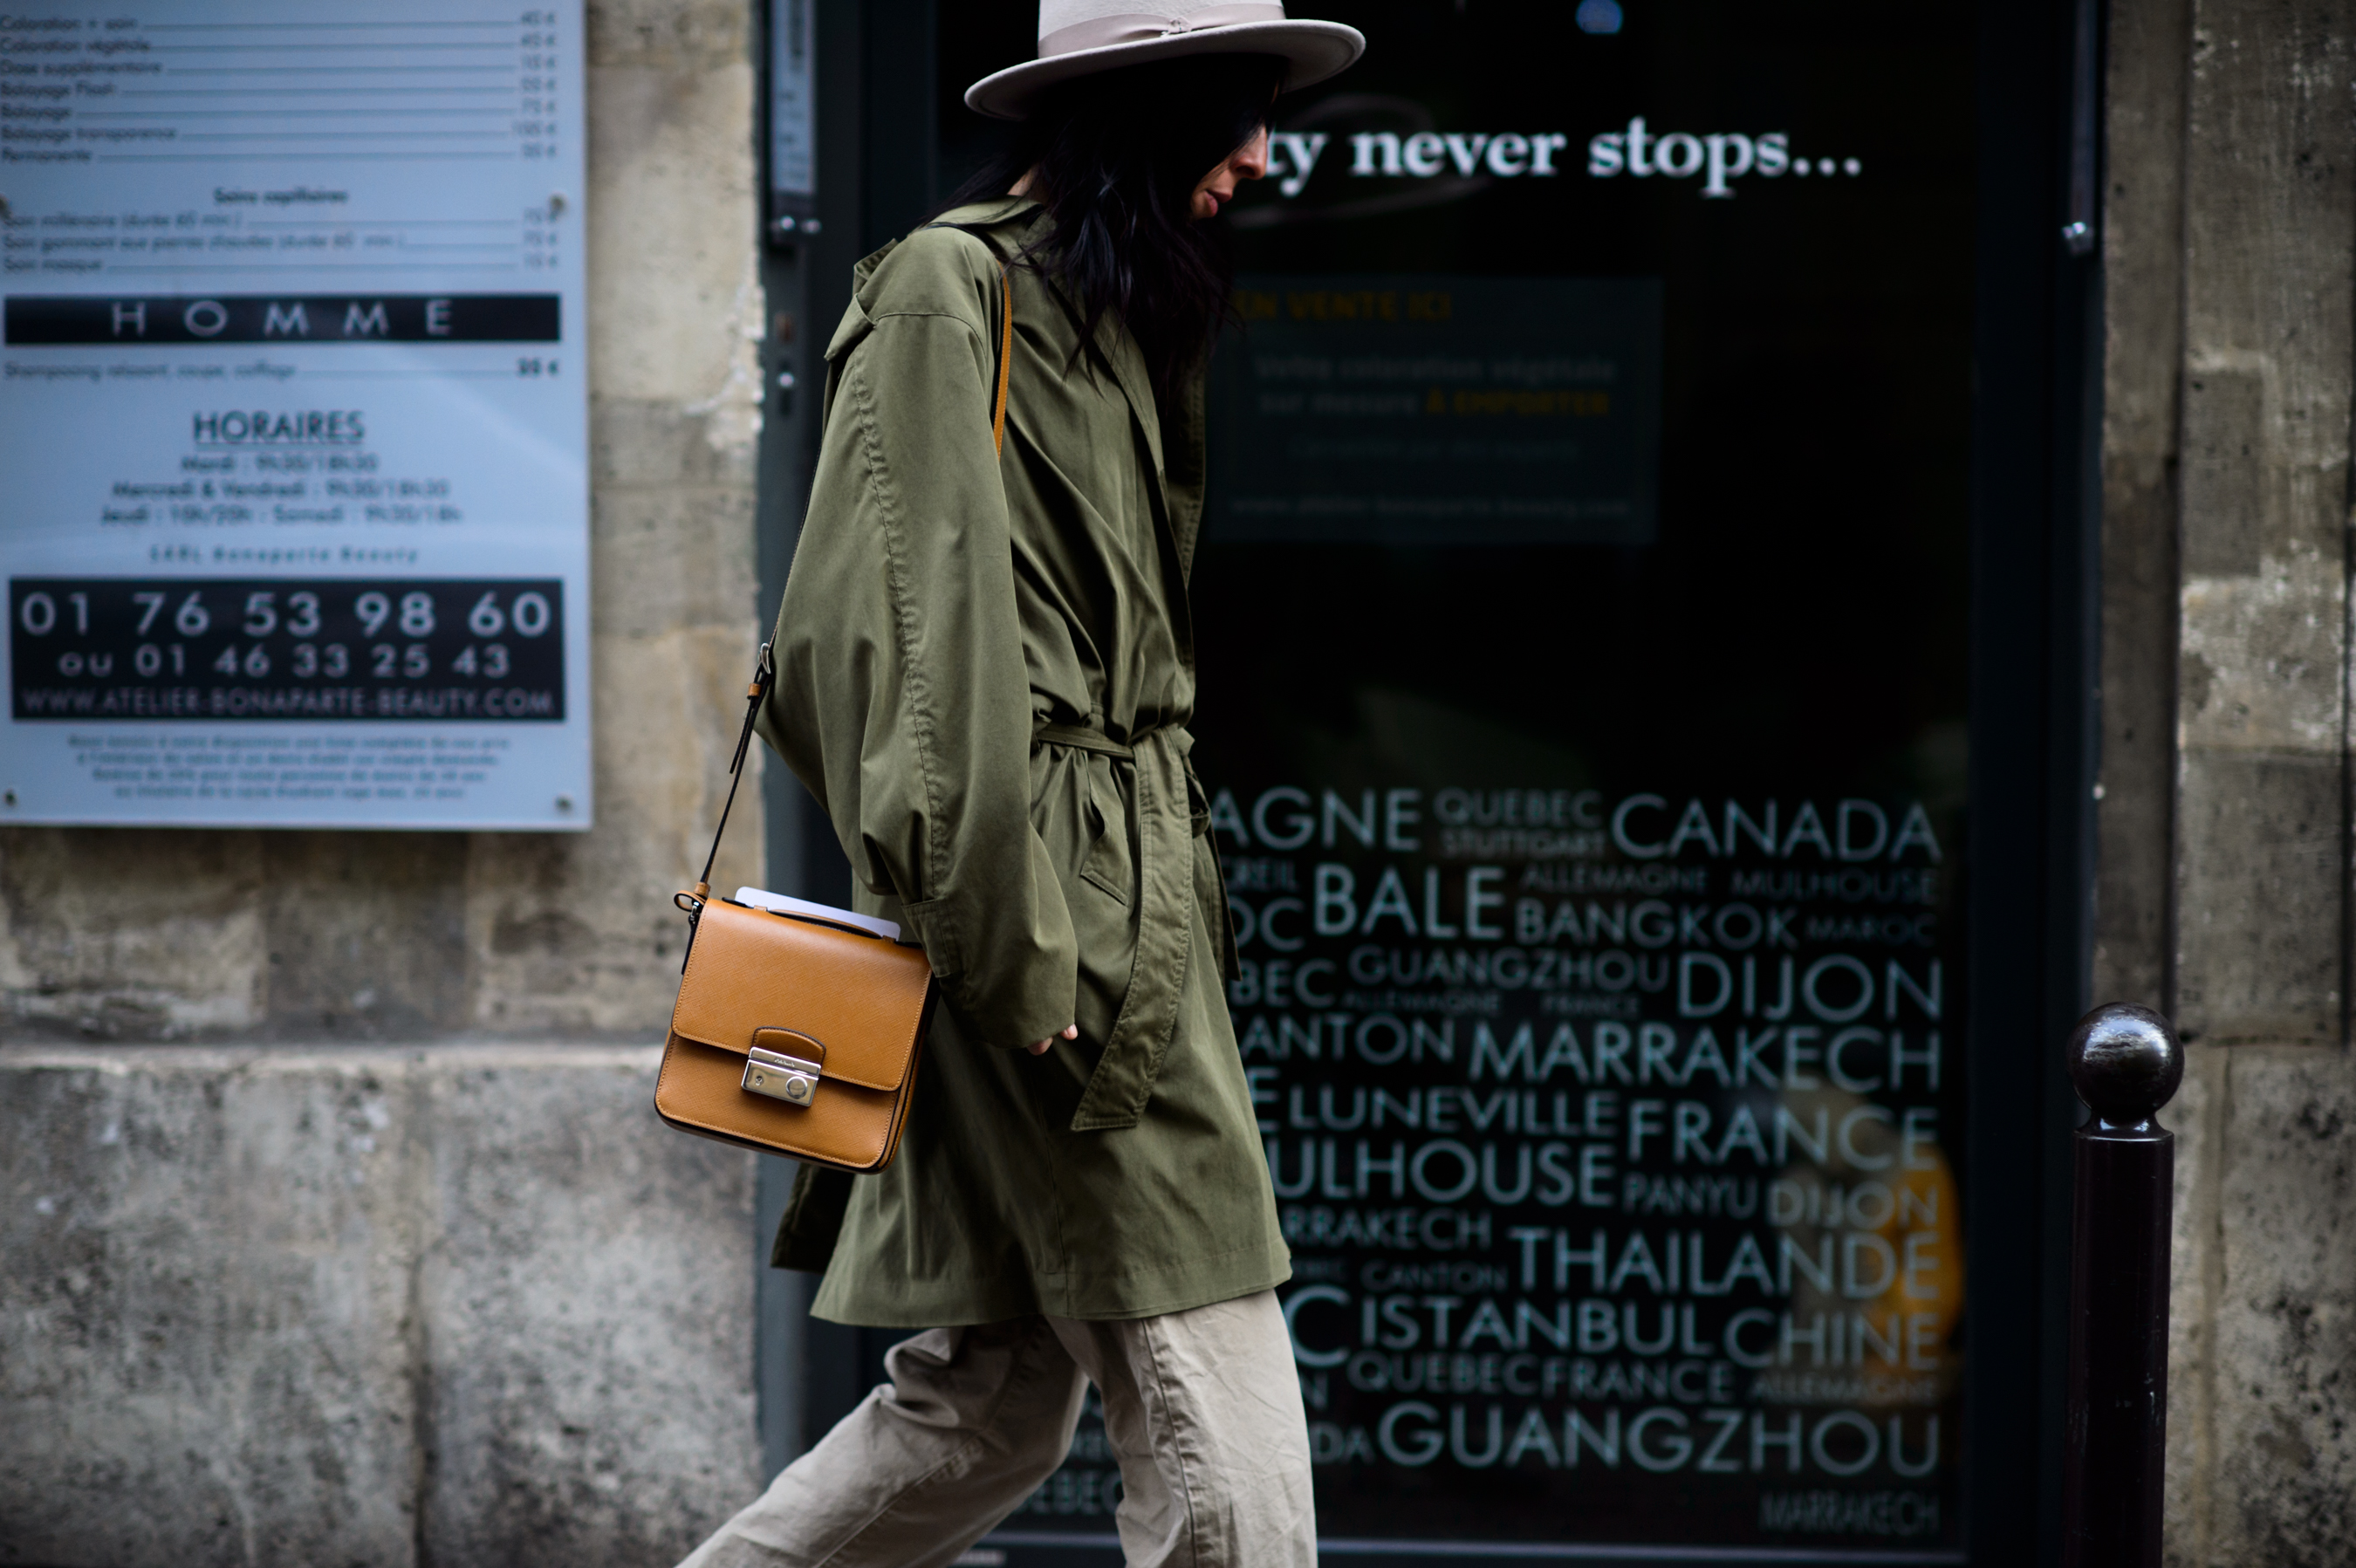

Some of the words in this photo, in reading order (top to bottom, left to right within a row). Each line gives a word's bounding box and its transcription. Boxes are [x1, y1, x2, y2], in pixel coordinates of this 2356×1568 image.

[1352, 127, 1567, 176] never
[1588, 116, 1860, 198] stops...
[112, 300, 451, 339] HOMME
[1287, 291, 1400, 322] VENTE
[1338, 352, 1485, 382] coloration
[193, 411, 366, 442] HORAIRES
[21, 592, 89, 637] 01
[133, 592, 209, 637] 76
[243, 592, 320, 637] 53
[354, 592, 435, 637] 98
[469, 592, 552, 637] 60
[58, 651, 113, 676] ou
[134, 645, 185, 677] 01
[214, 645, 270, 677] 46
[291, 645, 350, 677] 33
[372, 645, 430, 677] 25
[452, 645, 511, 677] 43
[1210, 784, 1422, 852] AGNE
[1434, 787, 1601, 829] QUEBEC
[1612, 793, 1942, 862] CANADA
[1443, 828, 1606, 859] STUTTGART
[1519, 859, 1708, 894] ALLEMAGNE
[1730, 866, 1938, 906] MULHOUSE
[1314, 863, 1504, 940] BALE
[1516, 898, 1798, 951] BANGKOK
[1807, 914, 1936, 948] MAROC
[1232, 958, 1337, 1010] BEC
[1348, 944, 1672, 993] GUANGZHOU
[1679, 950, 1942, 1023] DIJON
[1342, 988, 1501, 1017] ALLEMAGNE
[1542, 992, 1640, 1019] FRANCE
[1234, 1012, 1455, 1066] ANTON
[1469, 1019, 1942, 1094] MARRAKECH
[1289, 1085, 1620, 1139] LUNEVILLE
[1628, 1098, 1939, 1172] FRANCE
[1269, 1137, 1617, 1209] ULHOUSE
[1624, 1174, 1759, 1221] PANYU
[1768, 1179, 1939, 1228] DIJON
[1283, 1206, 1492, 1253] RRAKECH
[1359, 1257, 1509, 1294] CANTON
[1507, 1225, 1942, 1301] THAILANDE
[1283, 1284, 1352, 1368] C
[1359, 1295, 1712, 1358] ISTANBUL
[1724, 1307, 1940, 1371] CHINE
[1346, 1348, 1538, 1400] QUEBEC
[1541, 1357, 1736, 1403] FRANCE
[1749, 1373, 1939, 1407] ALLEMAGNE
[1312, 1421, 1377, 1466] DA
[1378, 1400, 1942, 1479] GUANGZHOU
[1014, 1469, 1125, 1515] EBEC
[1758, 1490, 1939, 1536] MARRAKECH
